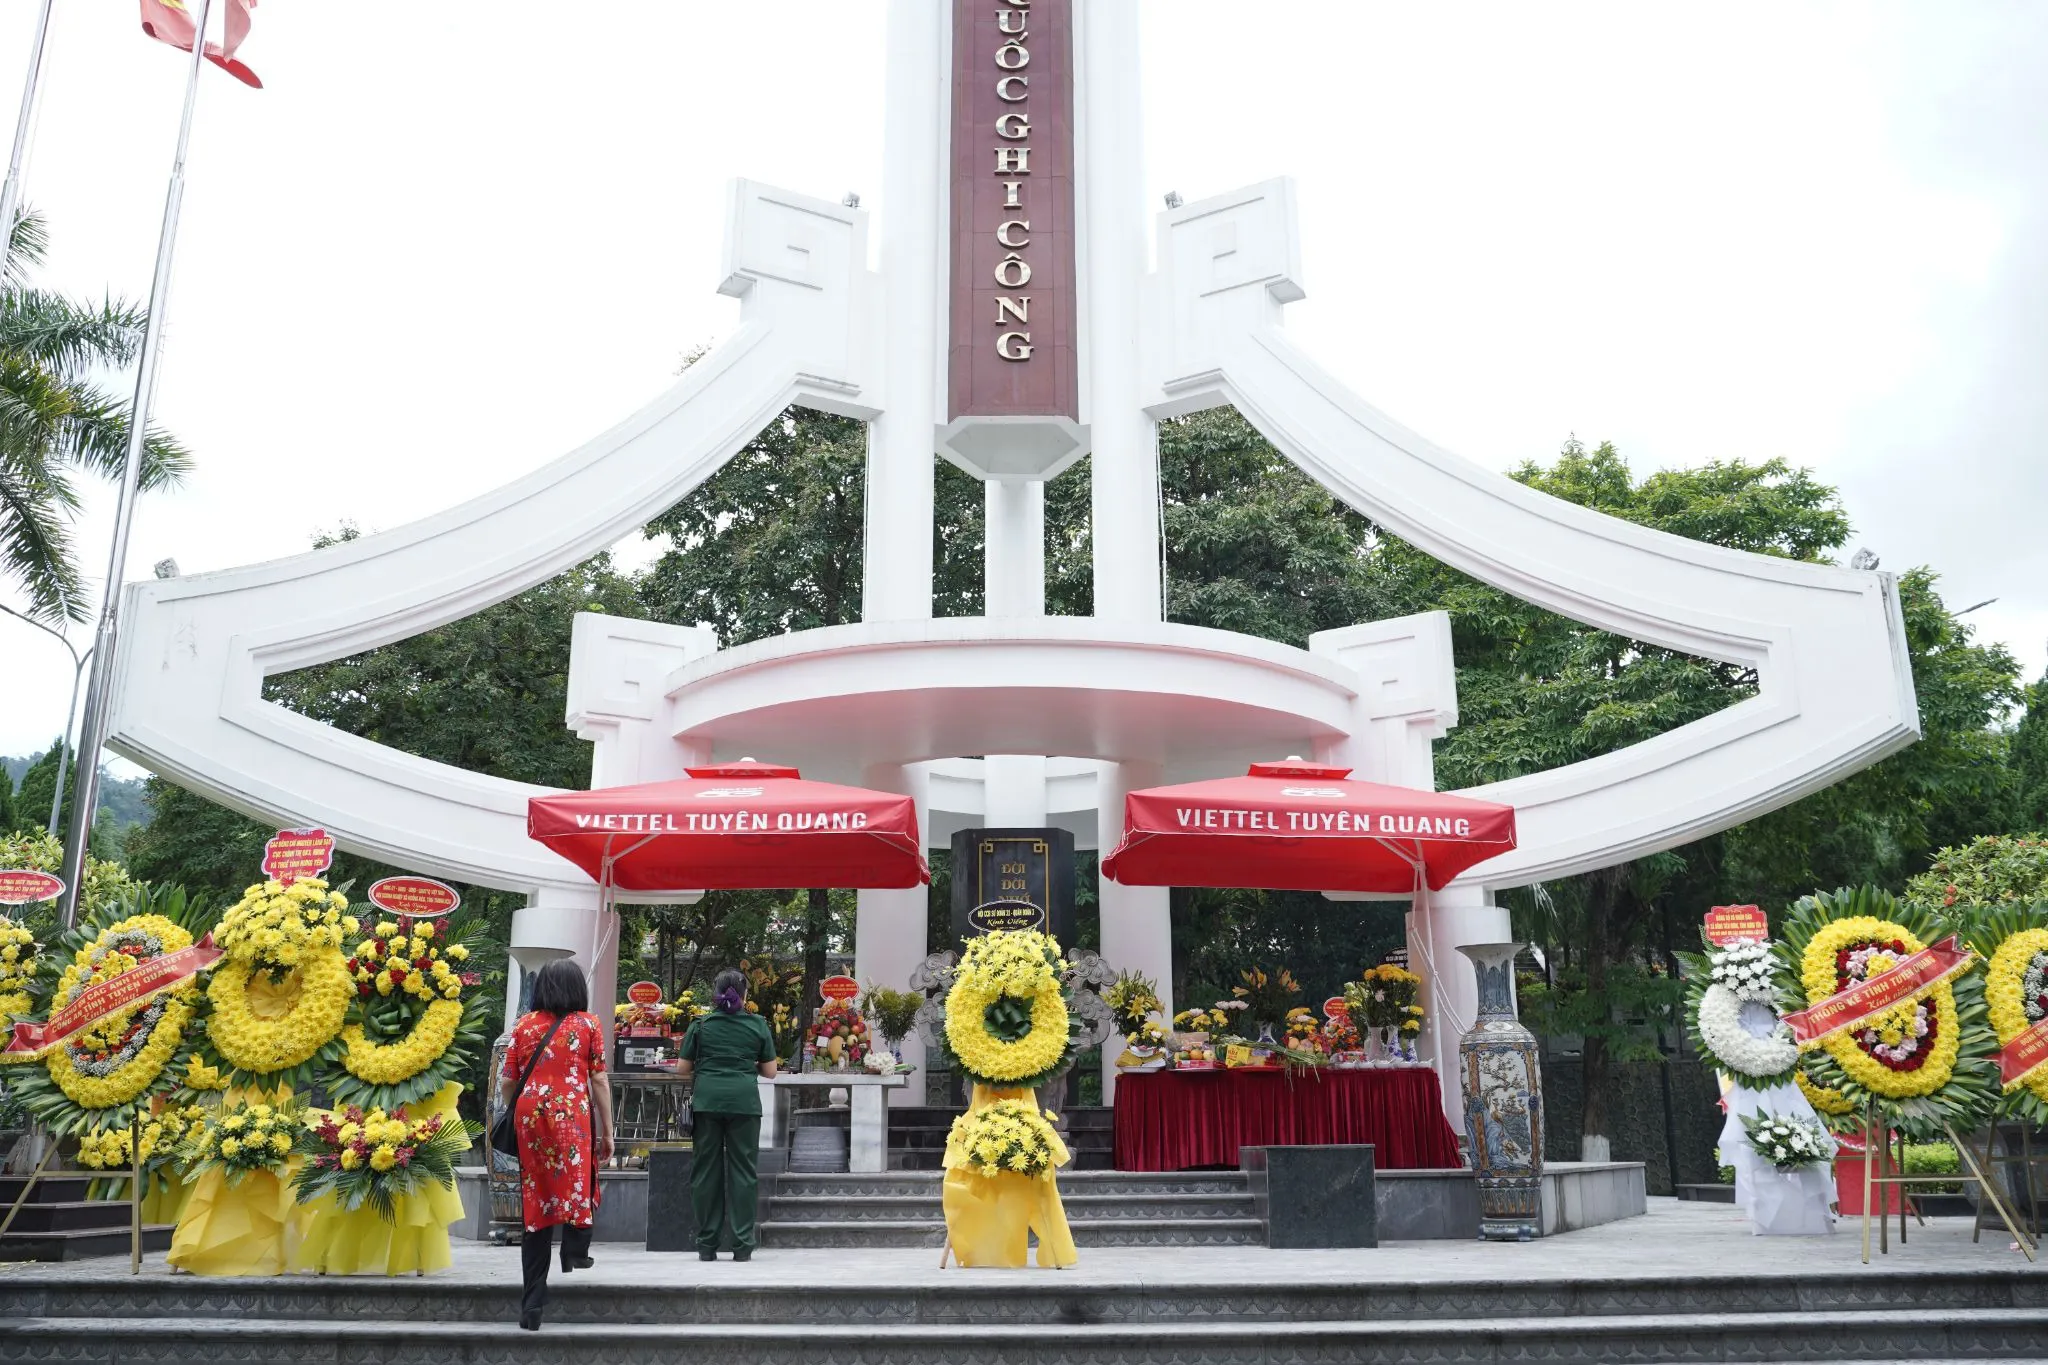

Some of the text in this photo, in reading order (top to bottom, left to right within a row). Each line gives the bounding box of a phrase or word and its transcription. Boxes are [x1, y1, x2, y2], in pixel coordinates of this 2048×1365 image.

[995, 0, 1030, 102] UỐC
[575, 810, 867, 831] VIETTEL TUYÊN QUANG
[1176, 808, 1470, 836] VIETTEL TUYÊN QUANG
[73, 1009, 82, 1020] AN
[143, 964, 178, 984] QUANG
[109, 976, 130, 990] ANH
[1846, 992, 1862, 1006] KÊ
